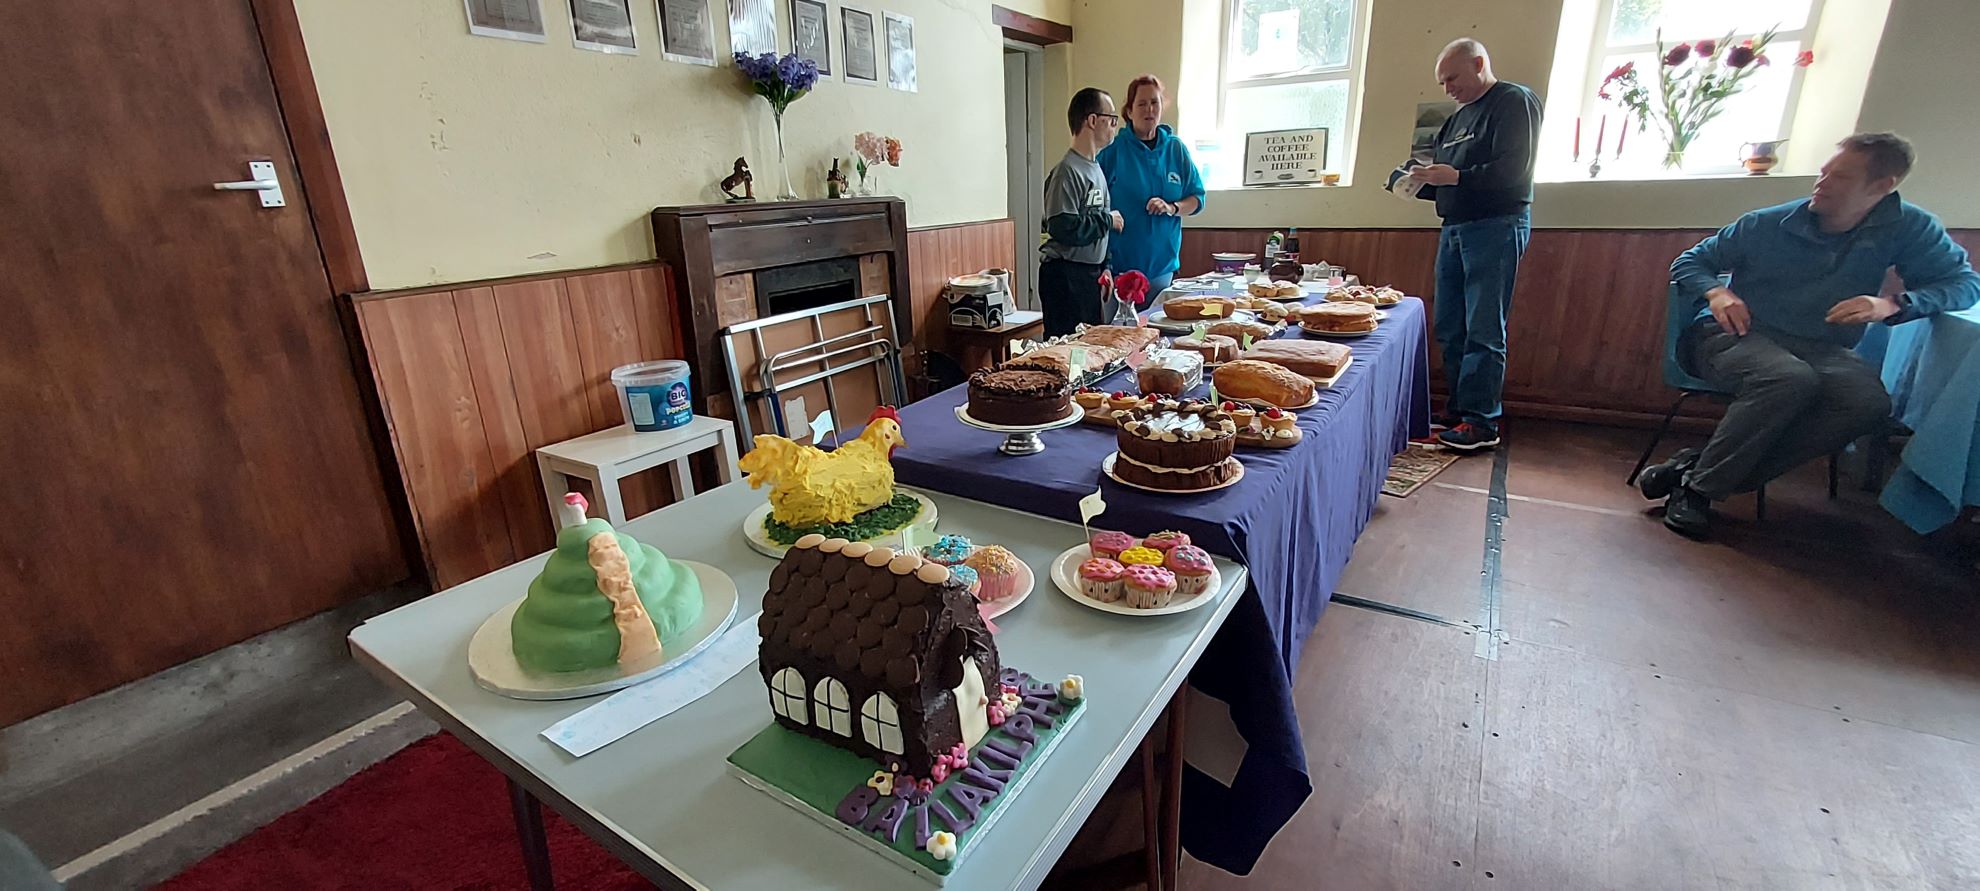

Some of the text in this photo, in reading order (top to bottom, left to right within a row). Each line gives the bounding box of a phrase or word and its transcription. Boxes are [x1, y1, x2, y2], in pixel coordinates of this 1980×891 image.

[1264, 134, 1314, 145] TEA AND
[1267, 143, 1309, 153] COFFEE
[1259, 152, 1317, 163] AVAILABLE
[1271, 161, 1303, 171] HERE
[1086, 189, 1104, 206] 12
